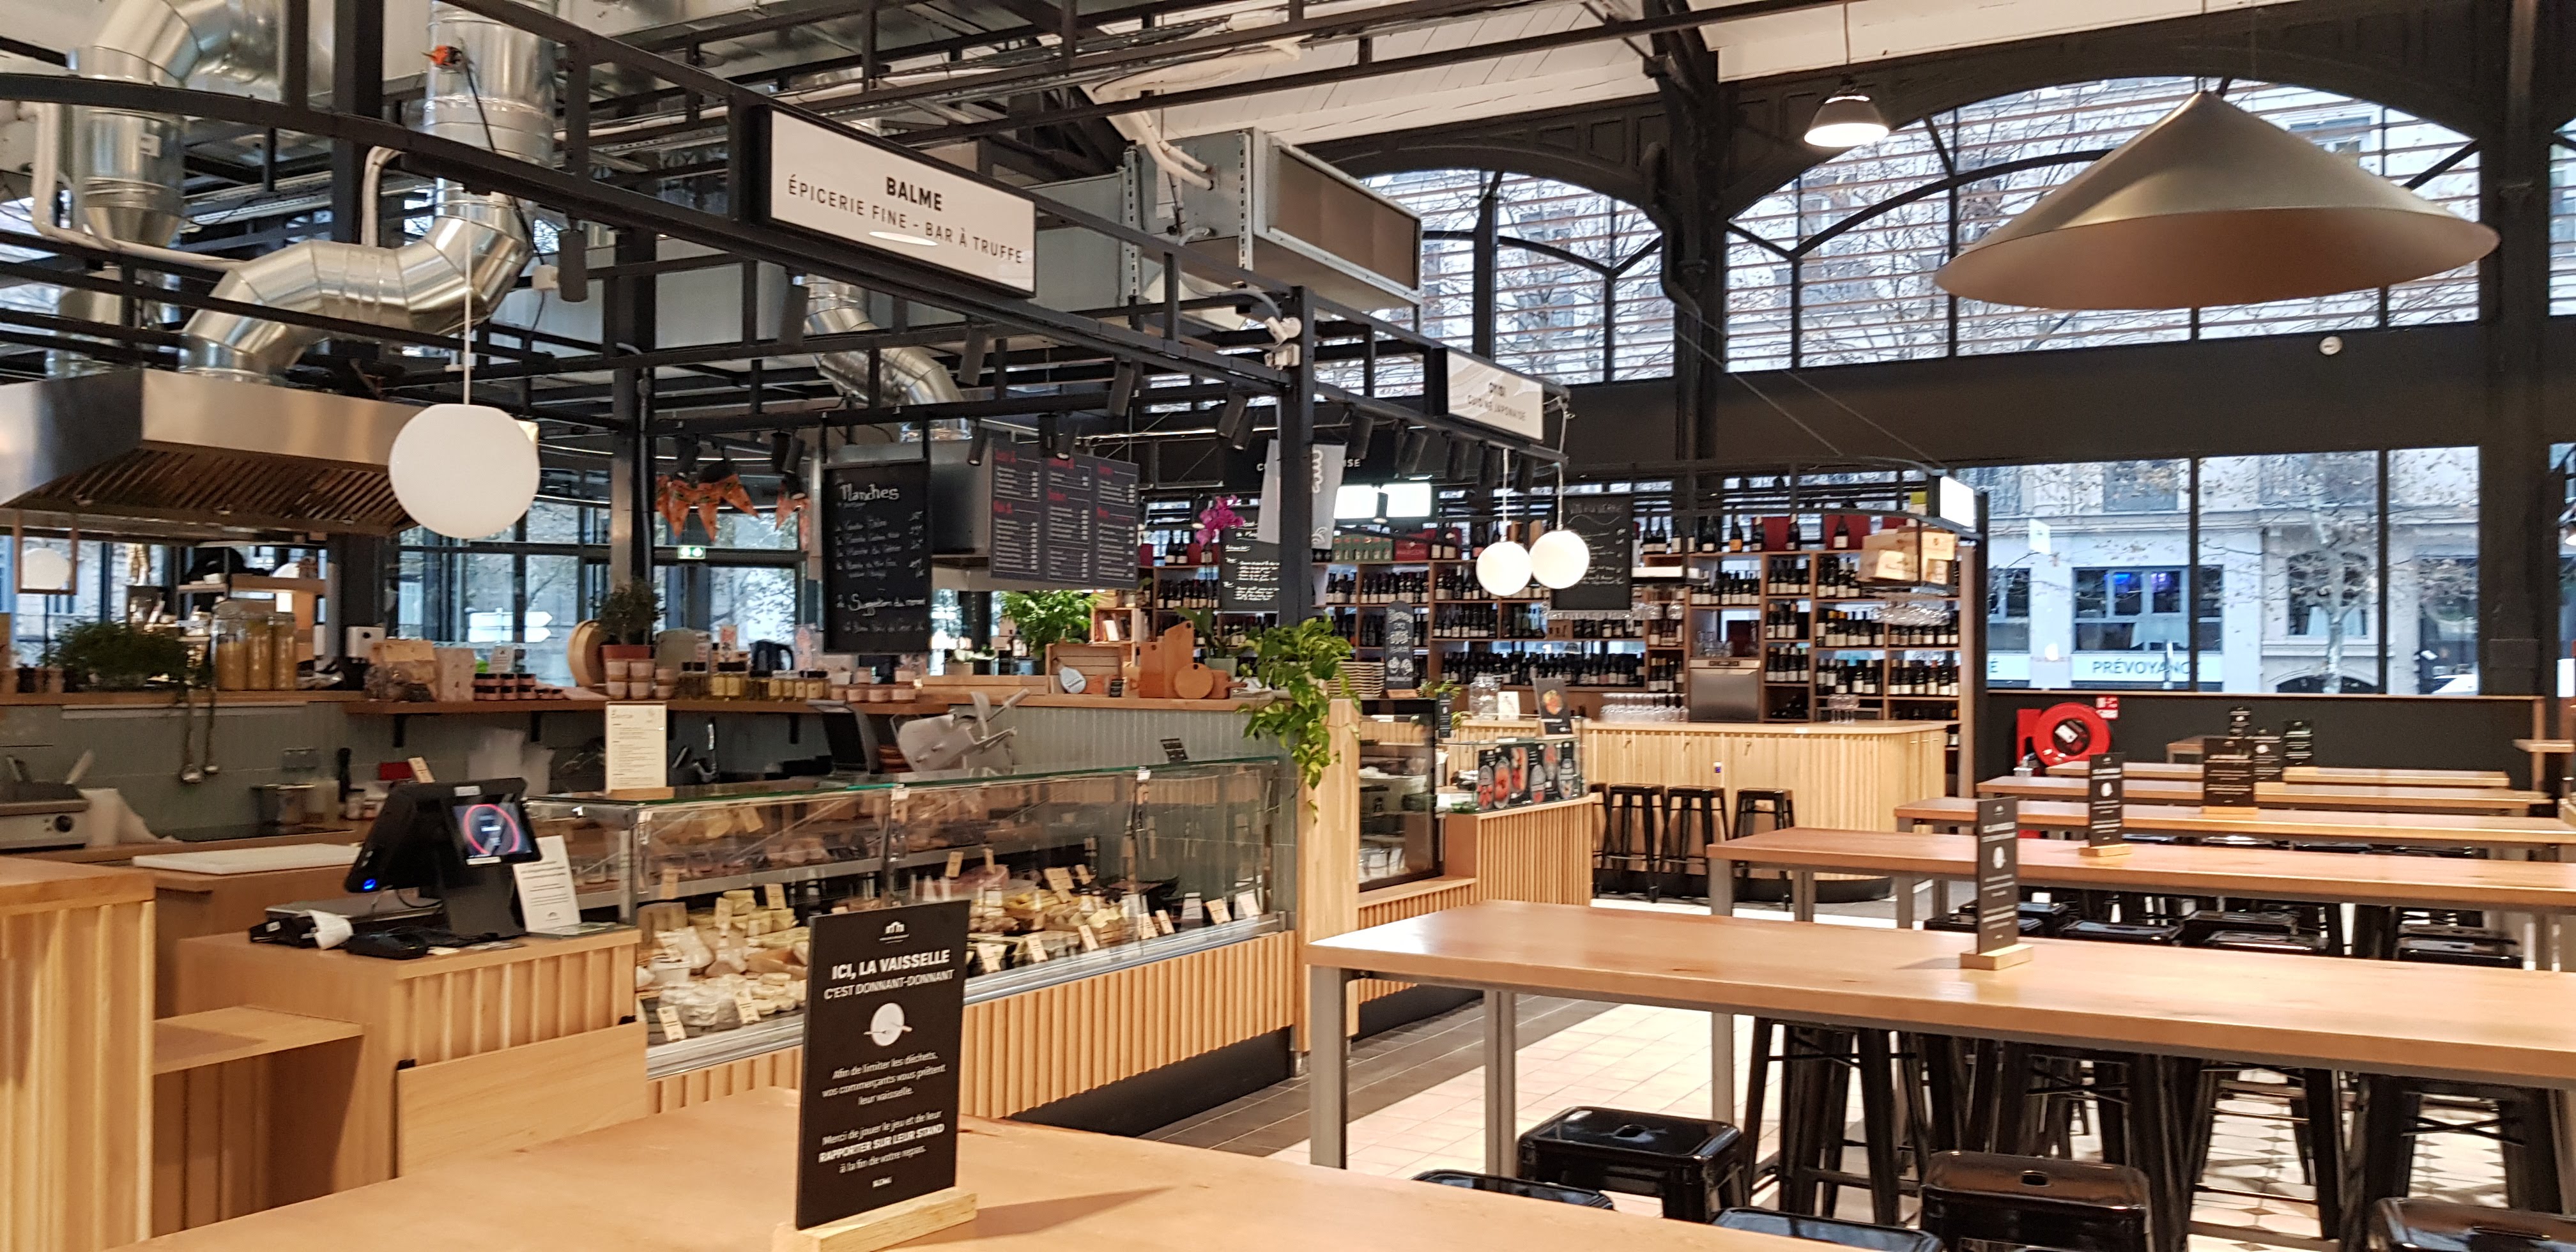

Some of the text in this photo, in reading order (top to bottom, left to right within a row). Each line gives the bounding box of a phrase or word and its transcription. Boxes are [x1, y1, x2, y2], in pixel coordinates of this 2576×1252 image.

[886, 176, 942, 211] BALME
[788, 173, 864, 216] ÉPICERIE
[872, 205, 907, 228] FINE
[925, 222, 953, 243] BAR
[958, 227, 967, 248] À
[972, 236, 1023, 264] TRUFFE
[2092, 658, 2198, 675] PRÉVOYANC
[831, 949, 951, 981] ICI, LA VAISSELLE
[855, 968, 956, 995] DONNANT-DONNANT
[891, 1058, 904, 1068] les
[822, 1087, 839, 1098] vos
[839, 1076, 896, 1094] commerçants
[896, 1071, 916, 1082] vous
[858, 1095, 876, 1105] leur
[822, 1131, 848, 1147] Merci
[848, 1129, 859, 1140] de
[857, 1124, 882, 1140] jouer
[890, 1119, 905, 1132] jeu
[914, 1113, 926, 1124] de
[926, 1110, 942, 1120] leur
[818, 1123, 946, 1163] RAPPORTER SUR LEUR STAND
[868, 1156, 880, 1166] de
